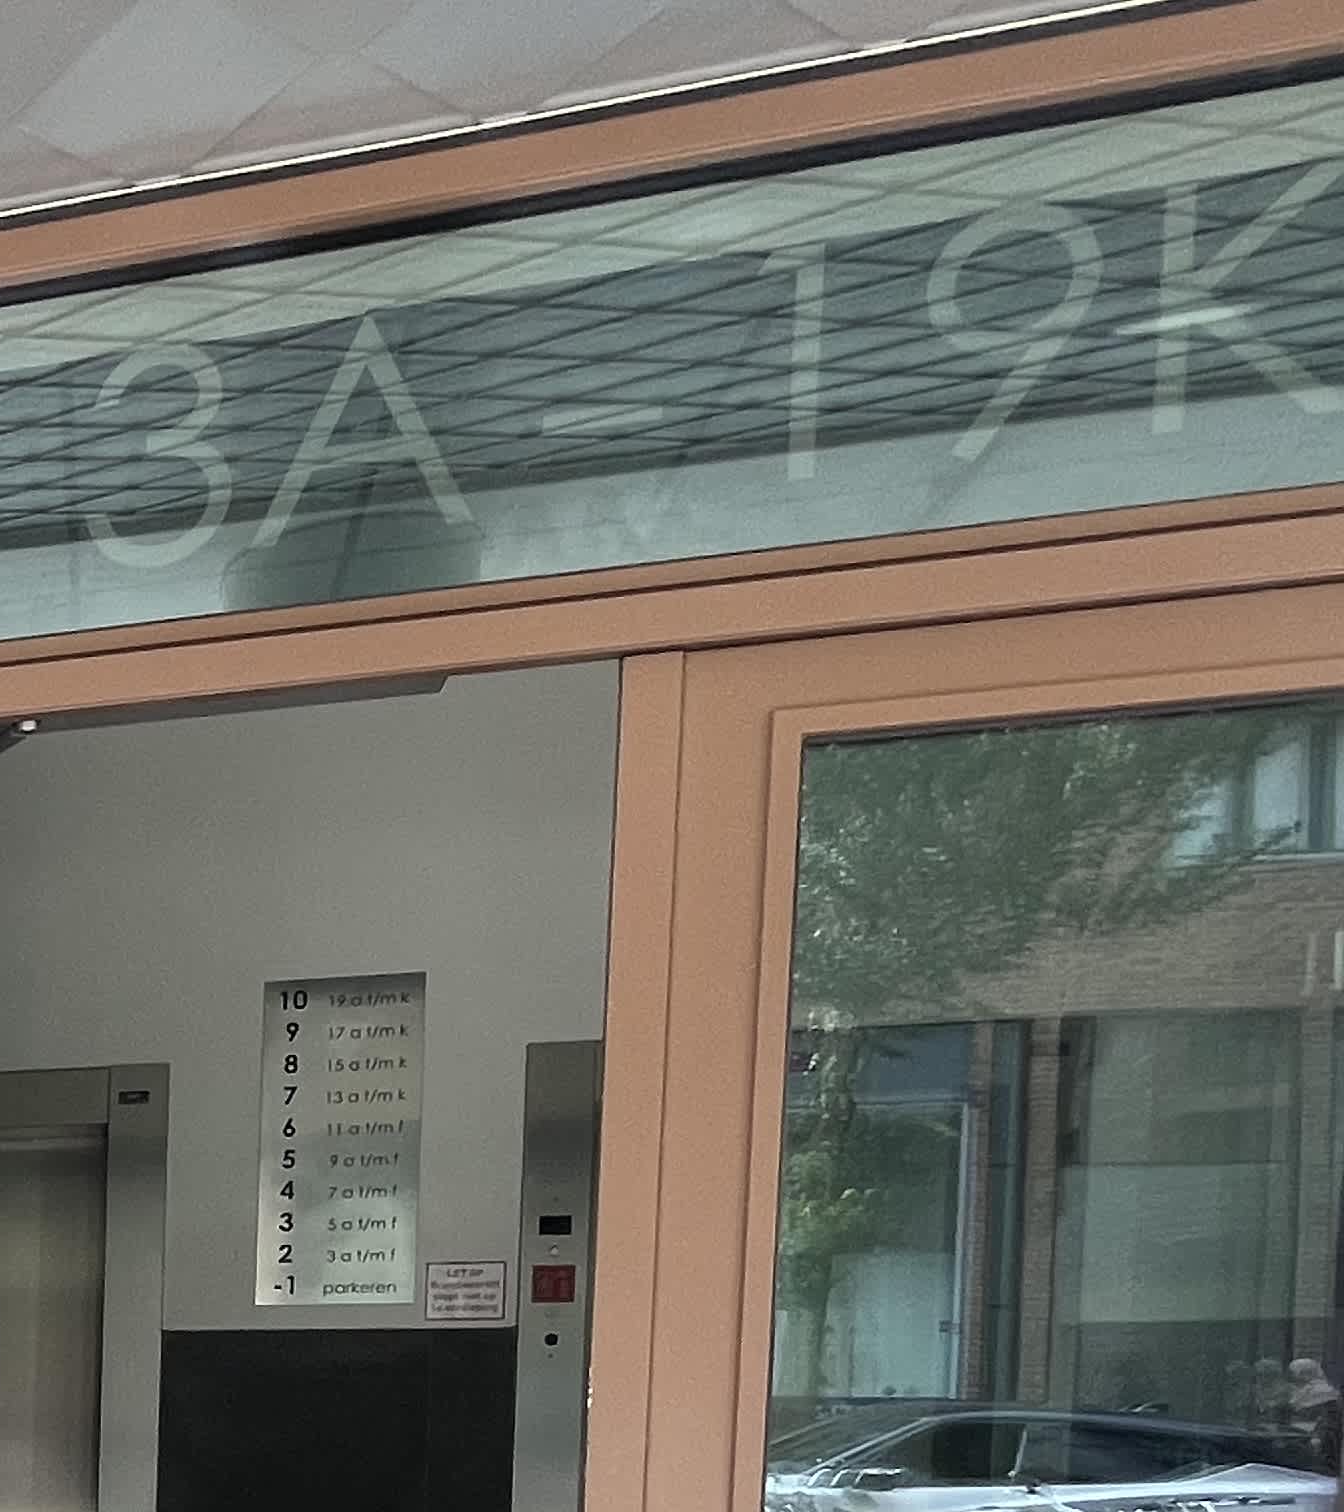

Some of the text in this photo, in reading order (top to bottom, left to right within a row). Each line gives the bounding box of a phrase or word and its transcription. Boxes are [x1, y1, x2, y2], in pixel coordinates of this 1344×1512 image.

[88, 314, 473, 568] 3A
[758, 155, 1344, 481] 19K
[280, 990, 308, 1010] 10
[329, 994, 346, 1007] 19
[400, 991, 410, 1003] k
[286, 1022, 299, 1042] 9
[329, 1027, 345, 1039] 17
[400, 1024, 409, 1036] k
[284, 1054, 298, 1074] 8
[328, 1059, 344, 1072] 15
[399, 1056, 407, 1068] k
[283, 1086, 298, 1105] 7
[327, 1091, 343, 1104] 13
[398, 1089, 407, 1100] k
[282, 1118, 296, 1137] 6
[328, 1123, 342, 1136] 11
[282, 1149, 295, 1169] 5
[330, 1155, 338, 1168] 9
[280, 1181, 294, 1199] 4
[329, 1186, 337, 1198] 7
[278, 1212, 294, 1232] 3
[328, 1218, 336, 1231] 5
[278, 1244, 293, 1264] 2
[327, 1251, 336, 1263] 3
[273, 1275, 397, 1296] -1 parkeren
